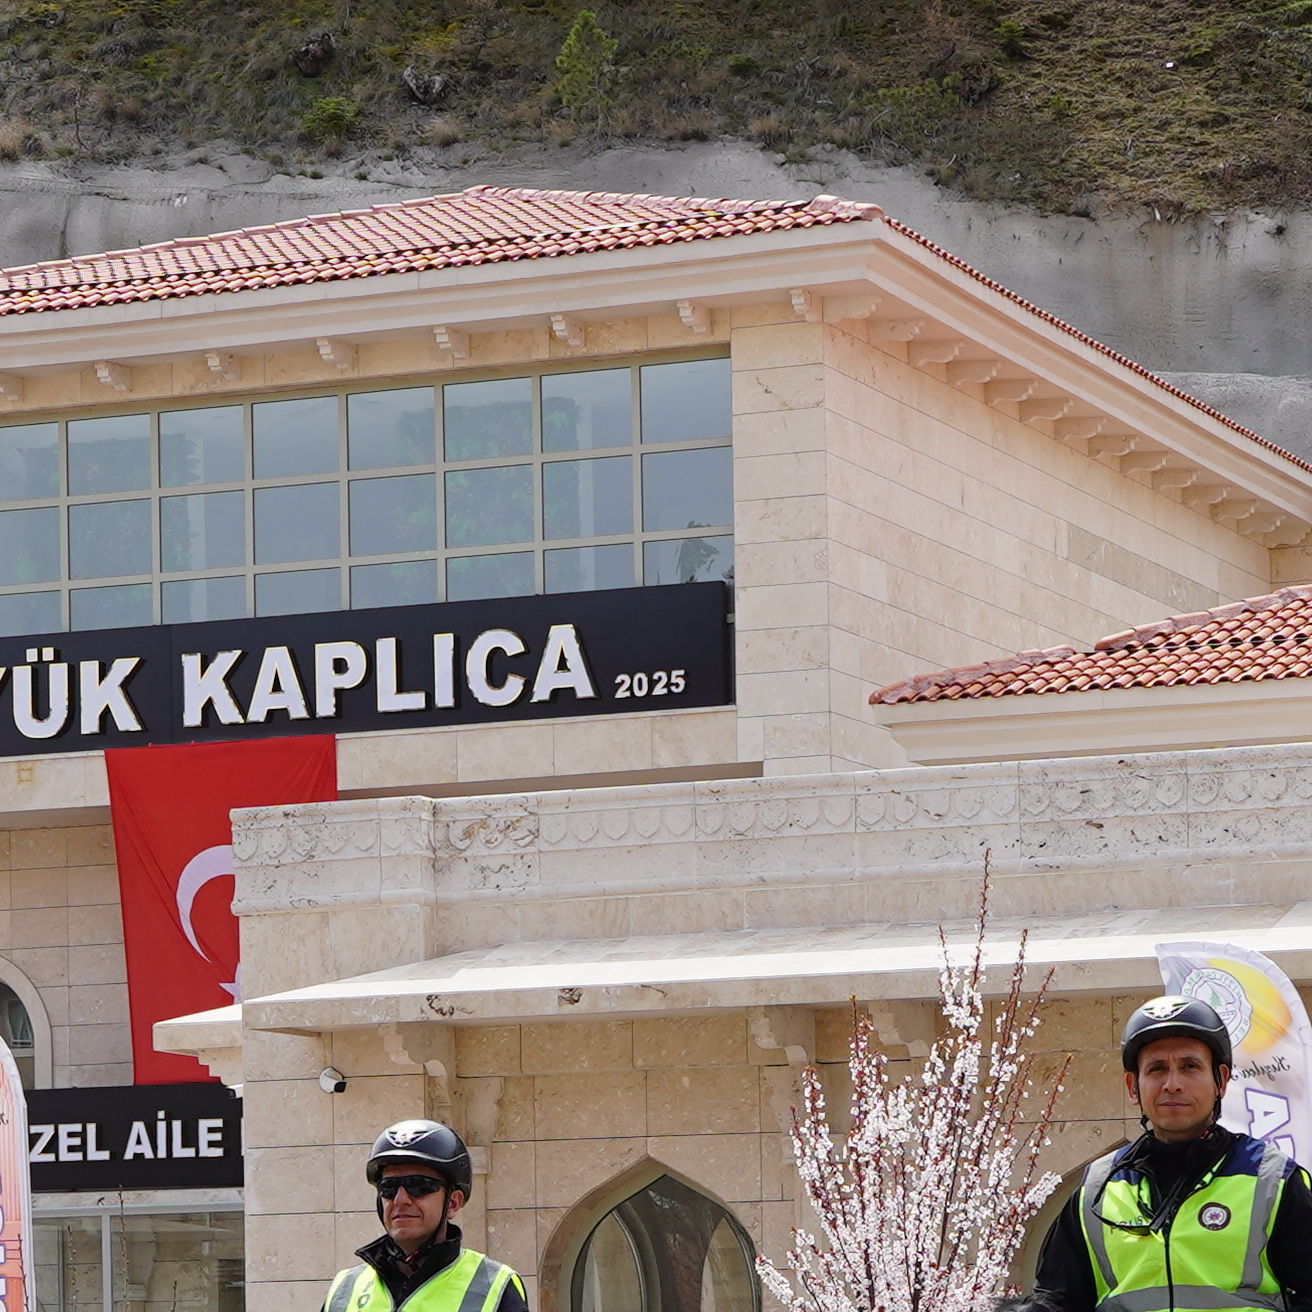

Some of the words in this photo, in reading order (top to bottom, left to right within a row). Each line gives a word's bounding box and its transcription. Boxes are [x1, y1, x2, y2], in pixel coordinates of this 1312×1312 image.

[181, 624, 597, 727] KAPLICA
[614, 670, 686, 699] 2025
[29, 1123, 110, 1162] ZEL
[123, 1110, 224, 1160] AİLE
